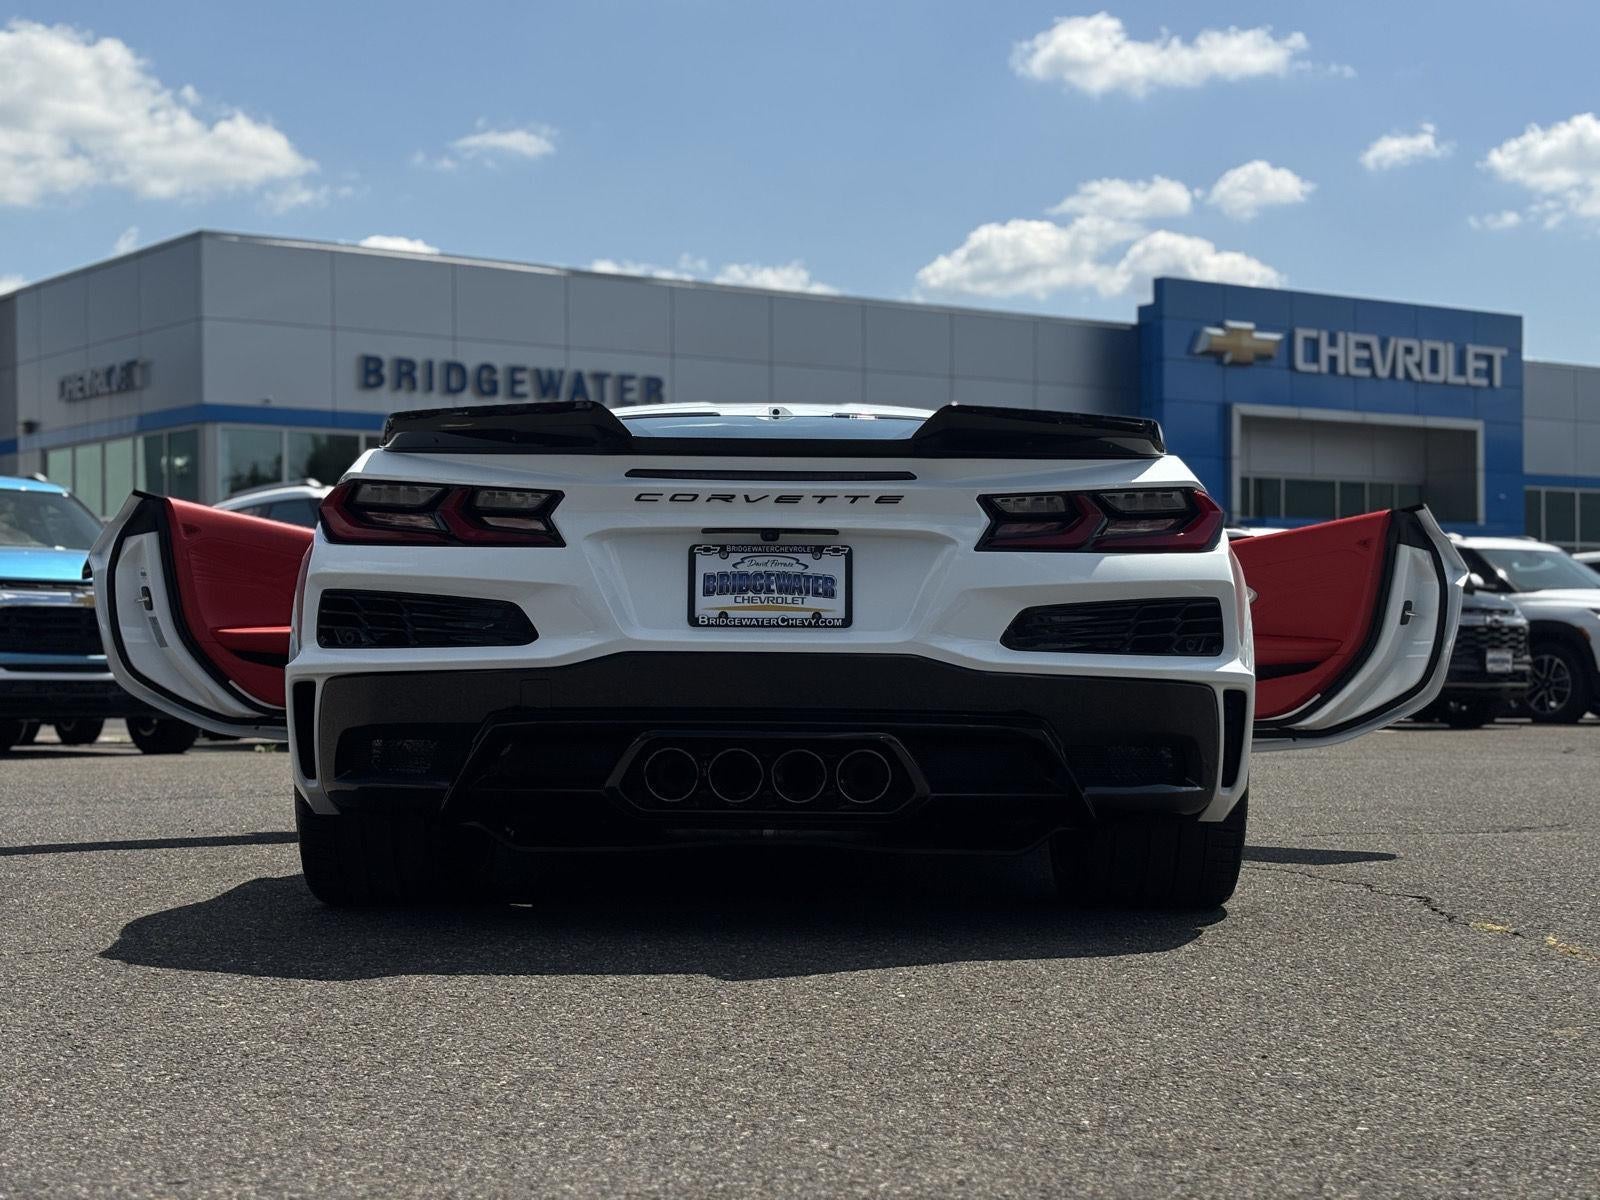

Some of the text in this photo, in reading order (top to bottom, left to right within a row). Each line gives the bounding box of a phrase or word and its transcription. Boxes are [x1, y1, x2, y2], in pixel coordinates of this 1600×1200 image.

[1294, 327, 1508, 388] CHEVROLET
[357, 354, 664, 405] BRIDGEWATER
[634, 493, 905, 505] CORVETTE
[702, 570, 838, 599] BRIDGEWATER
[734, 595, 807, 605] CHEVROLET
